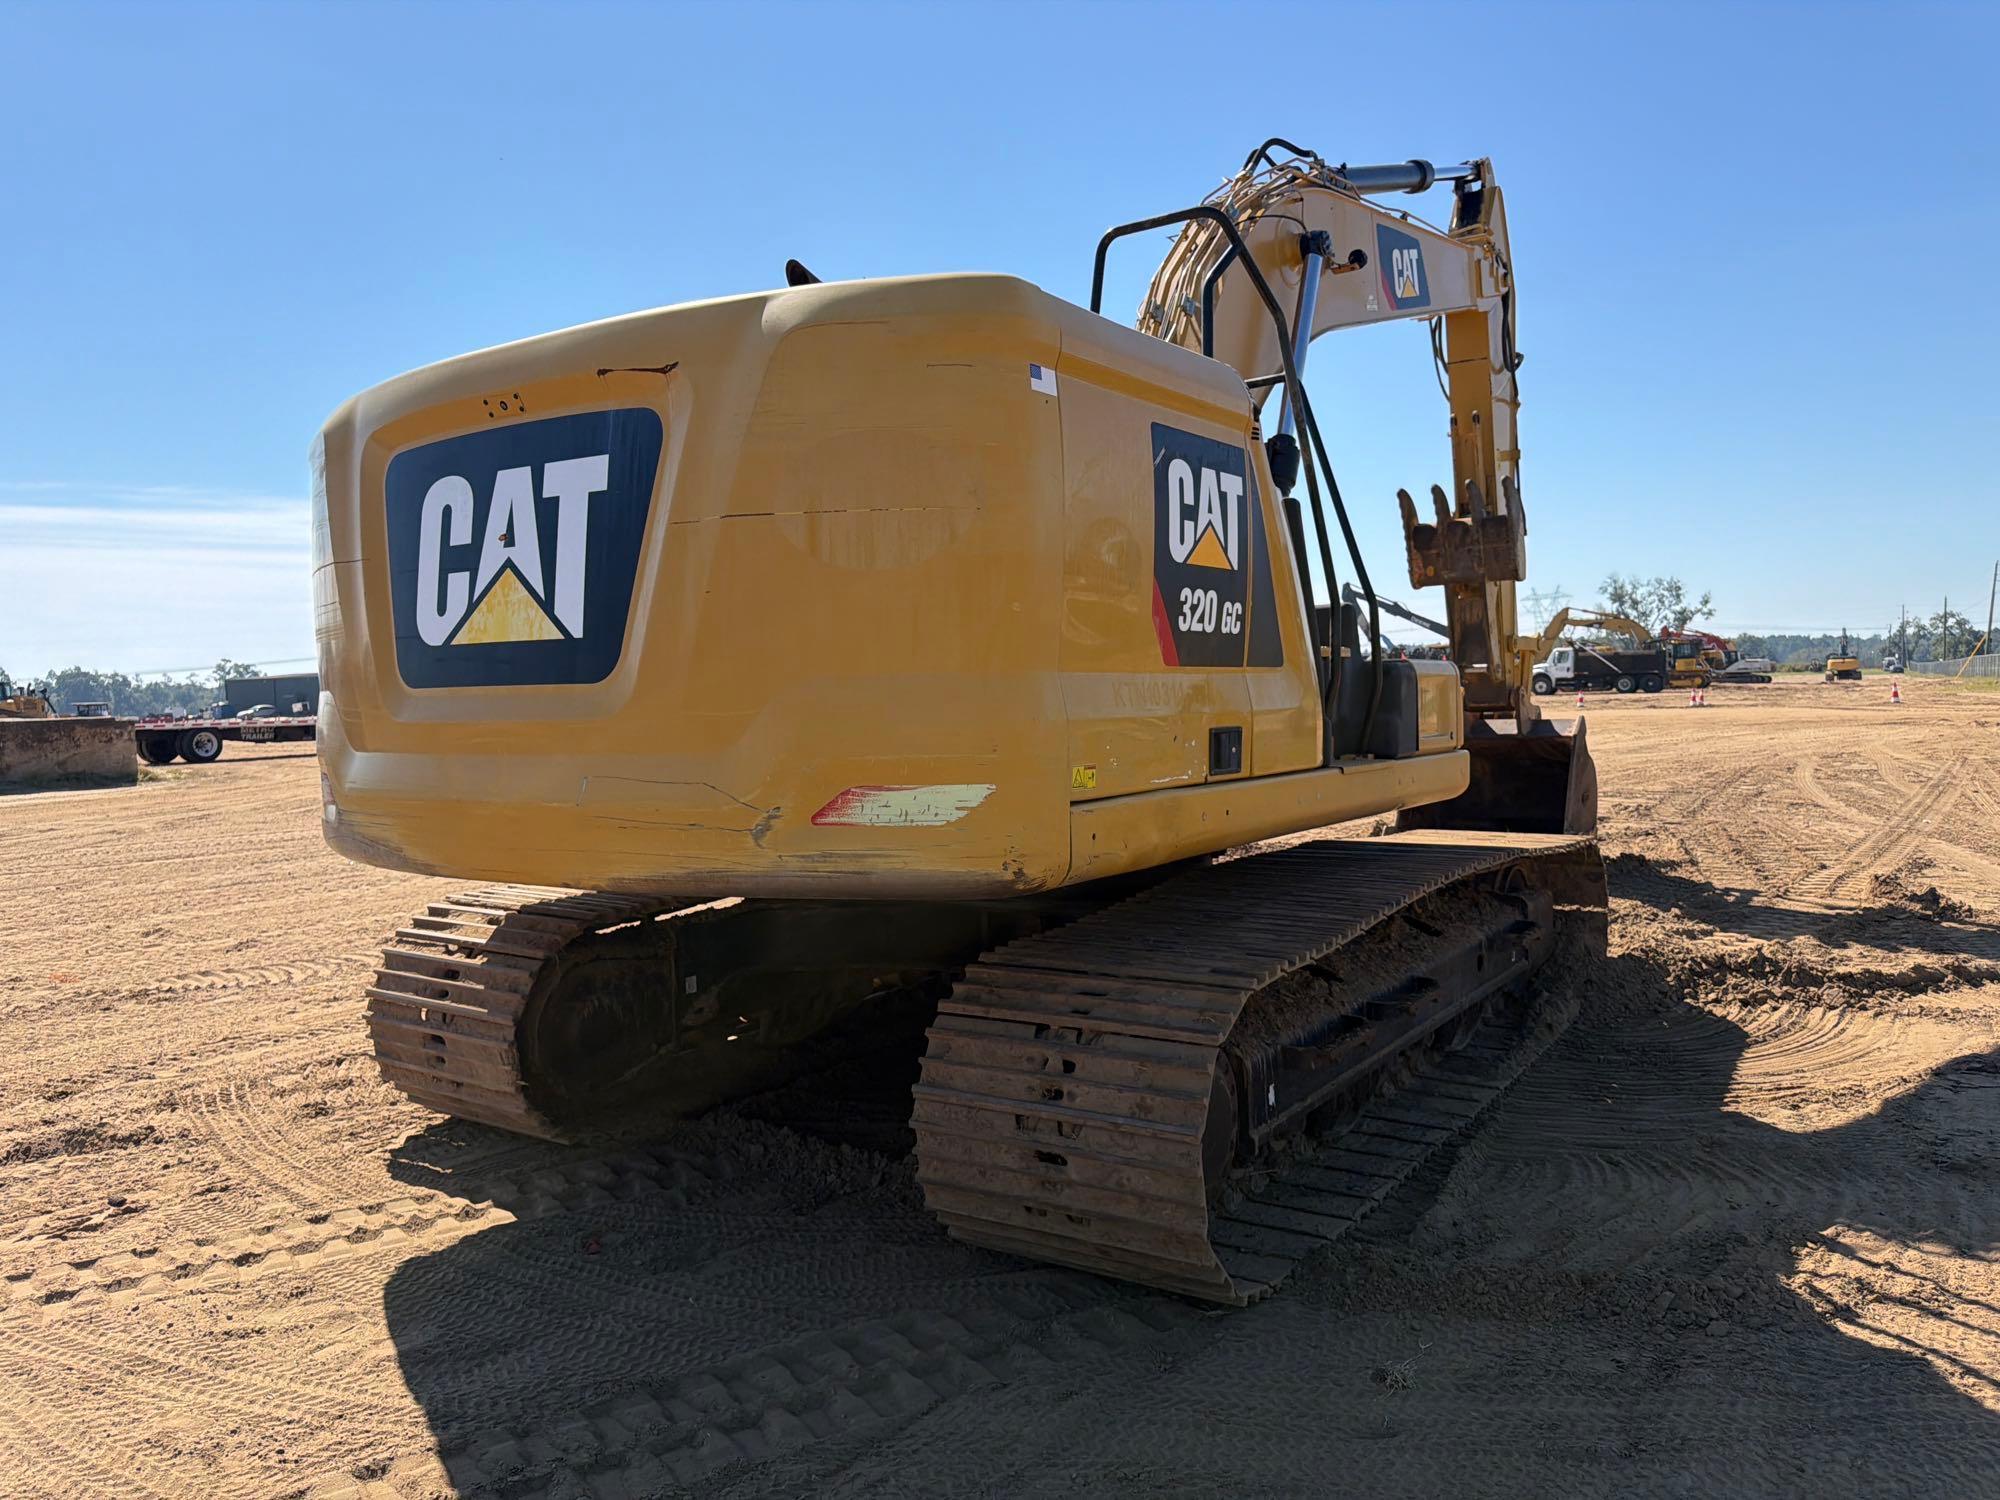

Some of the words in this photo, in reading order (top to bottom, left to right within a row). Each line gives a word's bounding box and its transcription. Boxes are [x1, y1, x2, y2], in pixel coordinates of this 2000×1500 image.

[1392, 248, 1420, 298] CAT
[416, 454, 610, 647] CAT
[1168, 458, 1243, 571] CAT
[1178, 587, 1218, 633] 320
[1221, 601, 1242, 635] GC
